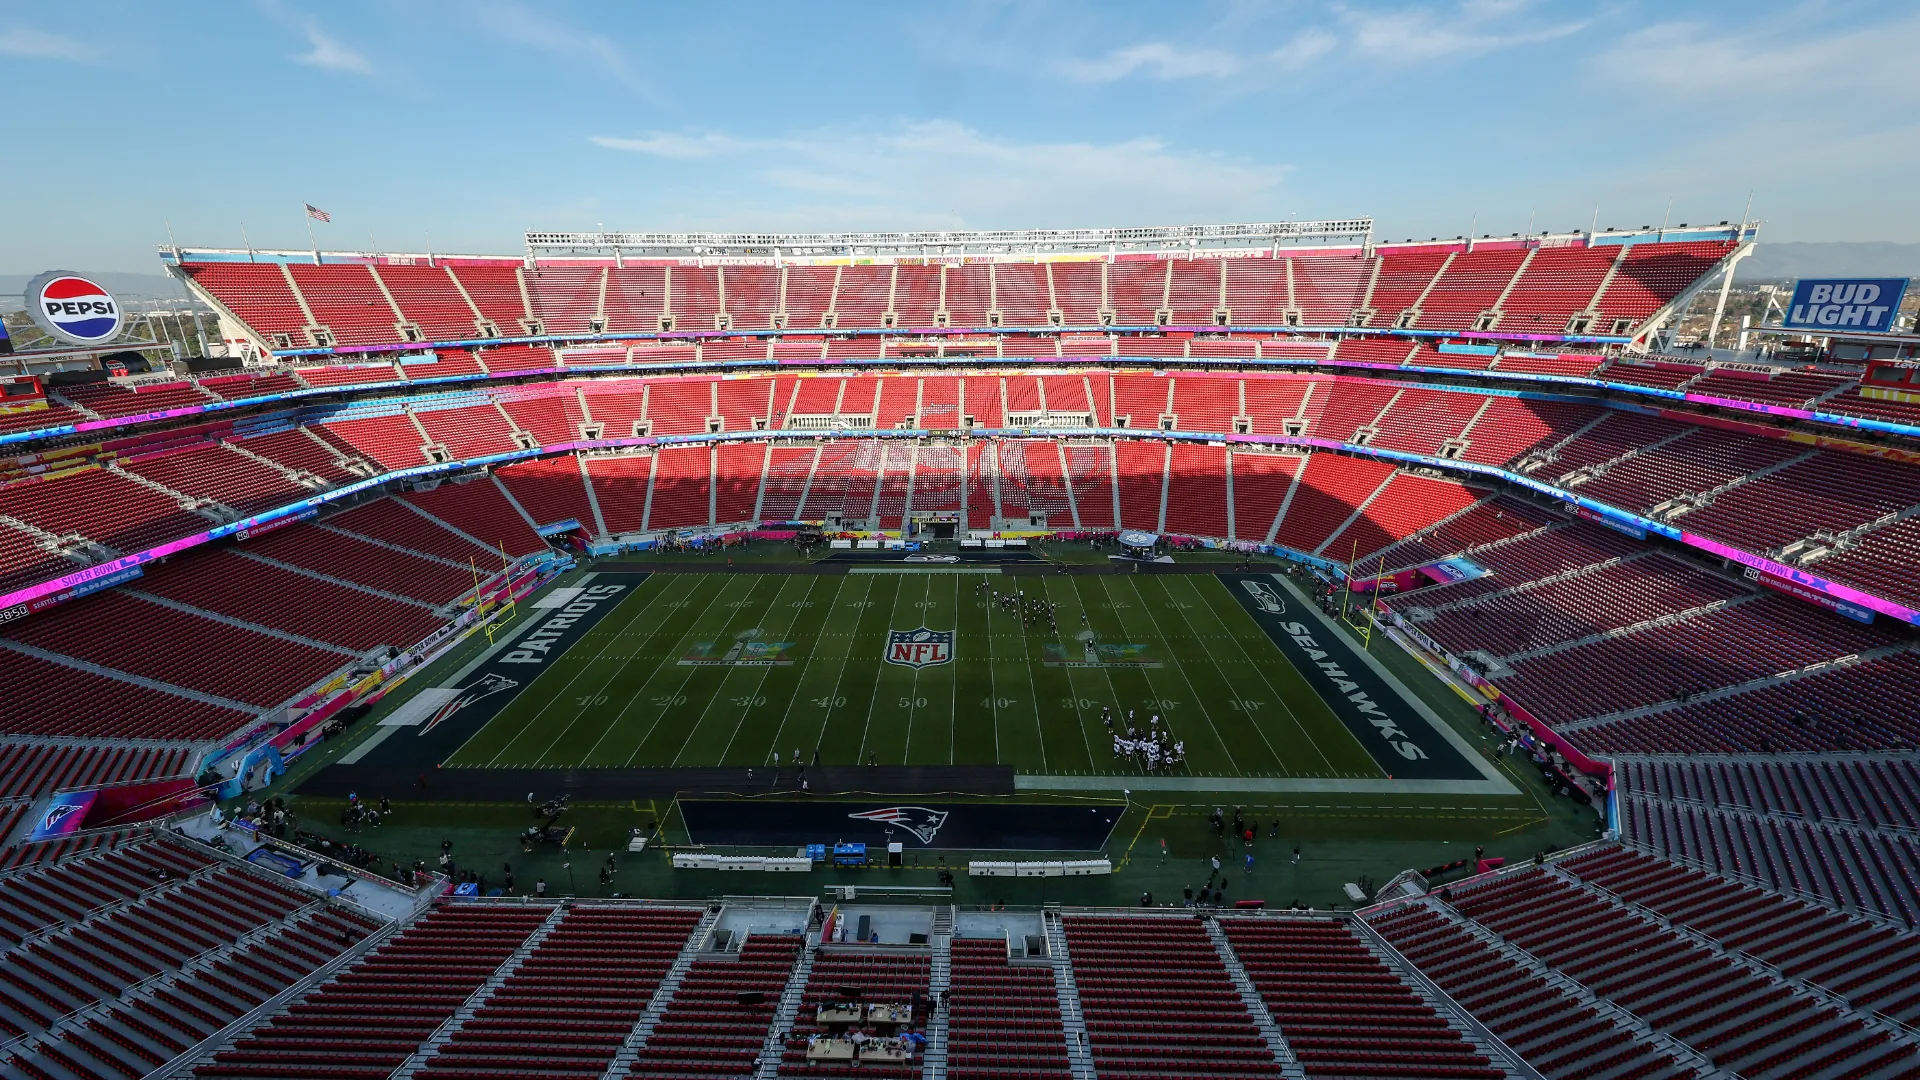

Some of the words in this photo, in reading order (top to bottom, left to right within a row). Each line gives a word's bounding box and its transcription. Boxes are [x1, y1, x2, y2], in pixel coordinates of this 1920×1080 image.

[1194, 251, 1264, 259] PATRIOTS
[1808, 284, 1881, 305] BUD
[45, 301, 115, 315] PEPSI
[1790, 304, 1889, 327] LIGHT
[1718, 399, 1733, 407] SUPER
[1749, 403, 1769, 412] LX
[116, 415, 133, 425] SUPER
[134, 414, 149, 423] BOWL
[149, 411, 168, 419] LX
[274, 508, 318, 528] PATRIOTS
[1592, 515, 1632, 536] SEAHAWKS
[61, 572, 92, 587] SUPER
[94, 562, 119, 577] BOWL
[119, 552, 154, 568] LX
[1736, 552, 1764, 570] SUPER
[1764, 561, 1790, 579] BOWL
[1790, 570, 1833, 592] LX
[1746, 569, 1758, 579] 40
[33, 596, 57, 609] SEATTLE
[57, 568, 141, 601] SEAHAWKS
[1760, 575, 1771, 584] NEW
[1771, 579, 1792, 591] ENGLAND
[1792, 587, 1869, 619] PATRIOTS
[498, 584, 627, 664] PATRIOTS
[408, 644, 425, 658] SUPER
[425, 634, 438, 647] BOWL
[438, 621, 457, 638] LX
[1404, 621, 1417, 638] SUPER
[1416, 630, 1429, 646] BOWL
[1430, 639, 1448, 657] LX
[892, 643, 946, 663] NFL
[1278, 621, 1430, 760] SEAHAWKS
[577, 695, 608, 706] 10
[655, 695, 687, 706] 20
[736, 695, 767, 707] 30
[817, 696, 847, 707] 40
[898, 697, 928, 708] 50
[980, 697, 1009, 709] 40
[1061, 698, 1092, 709] 30
[1143, 698, 1175, 710] 20
[1228, 699, 1259, 711] 10
